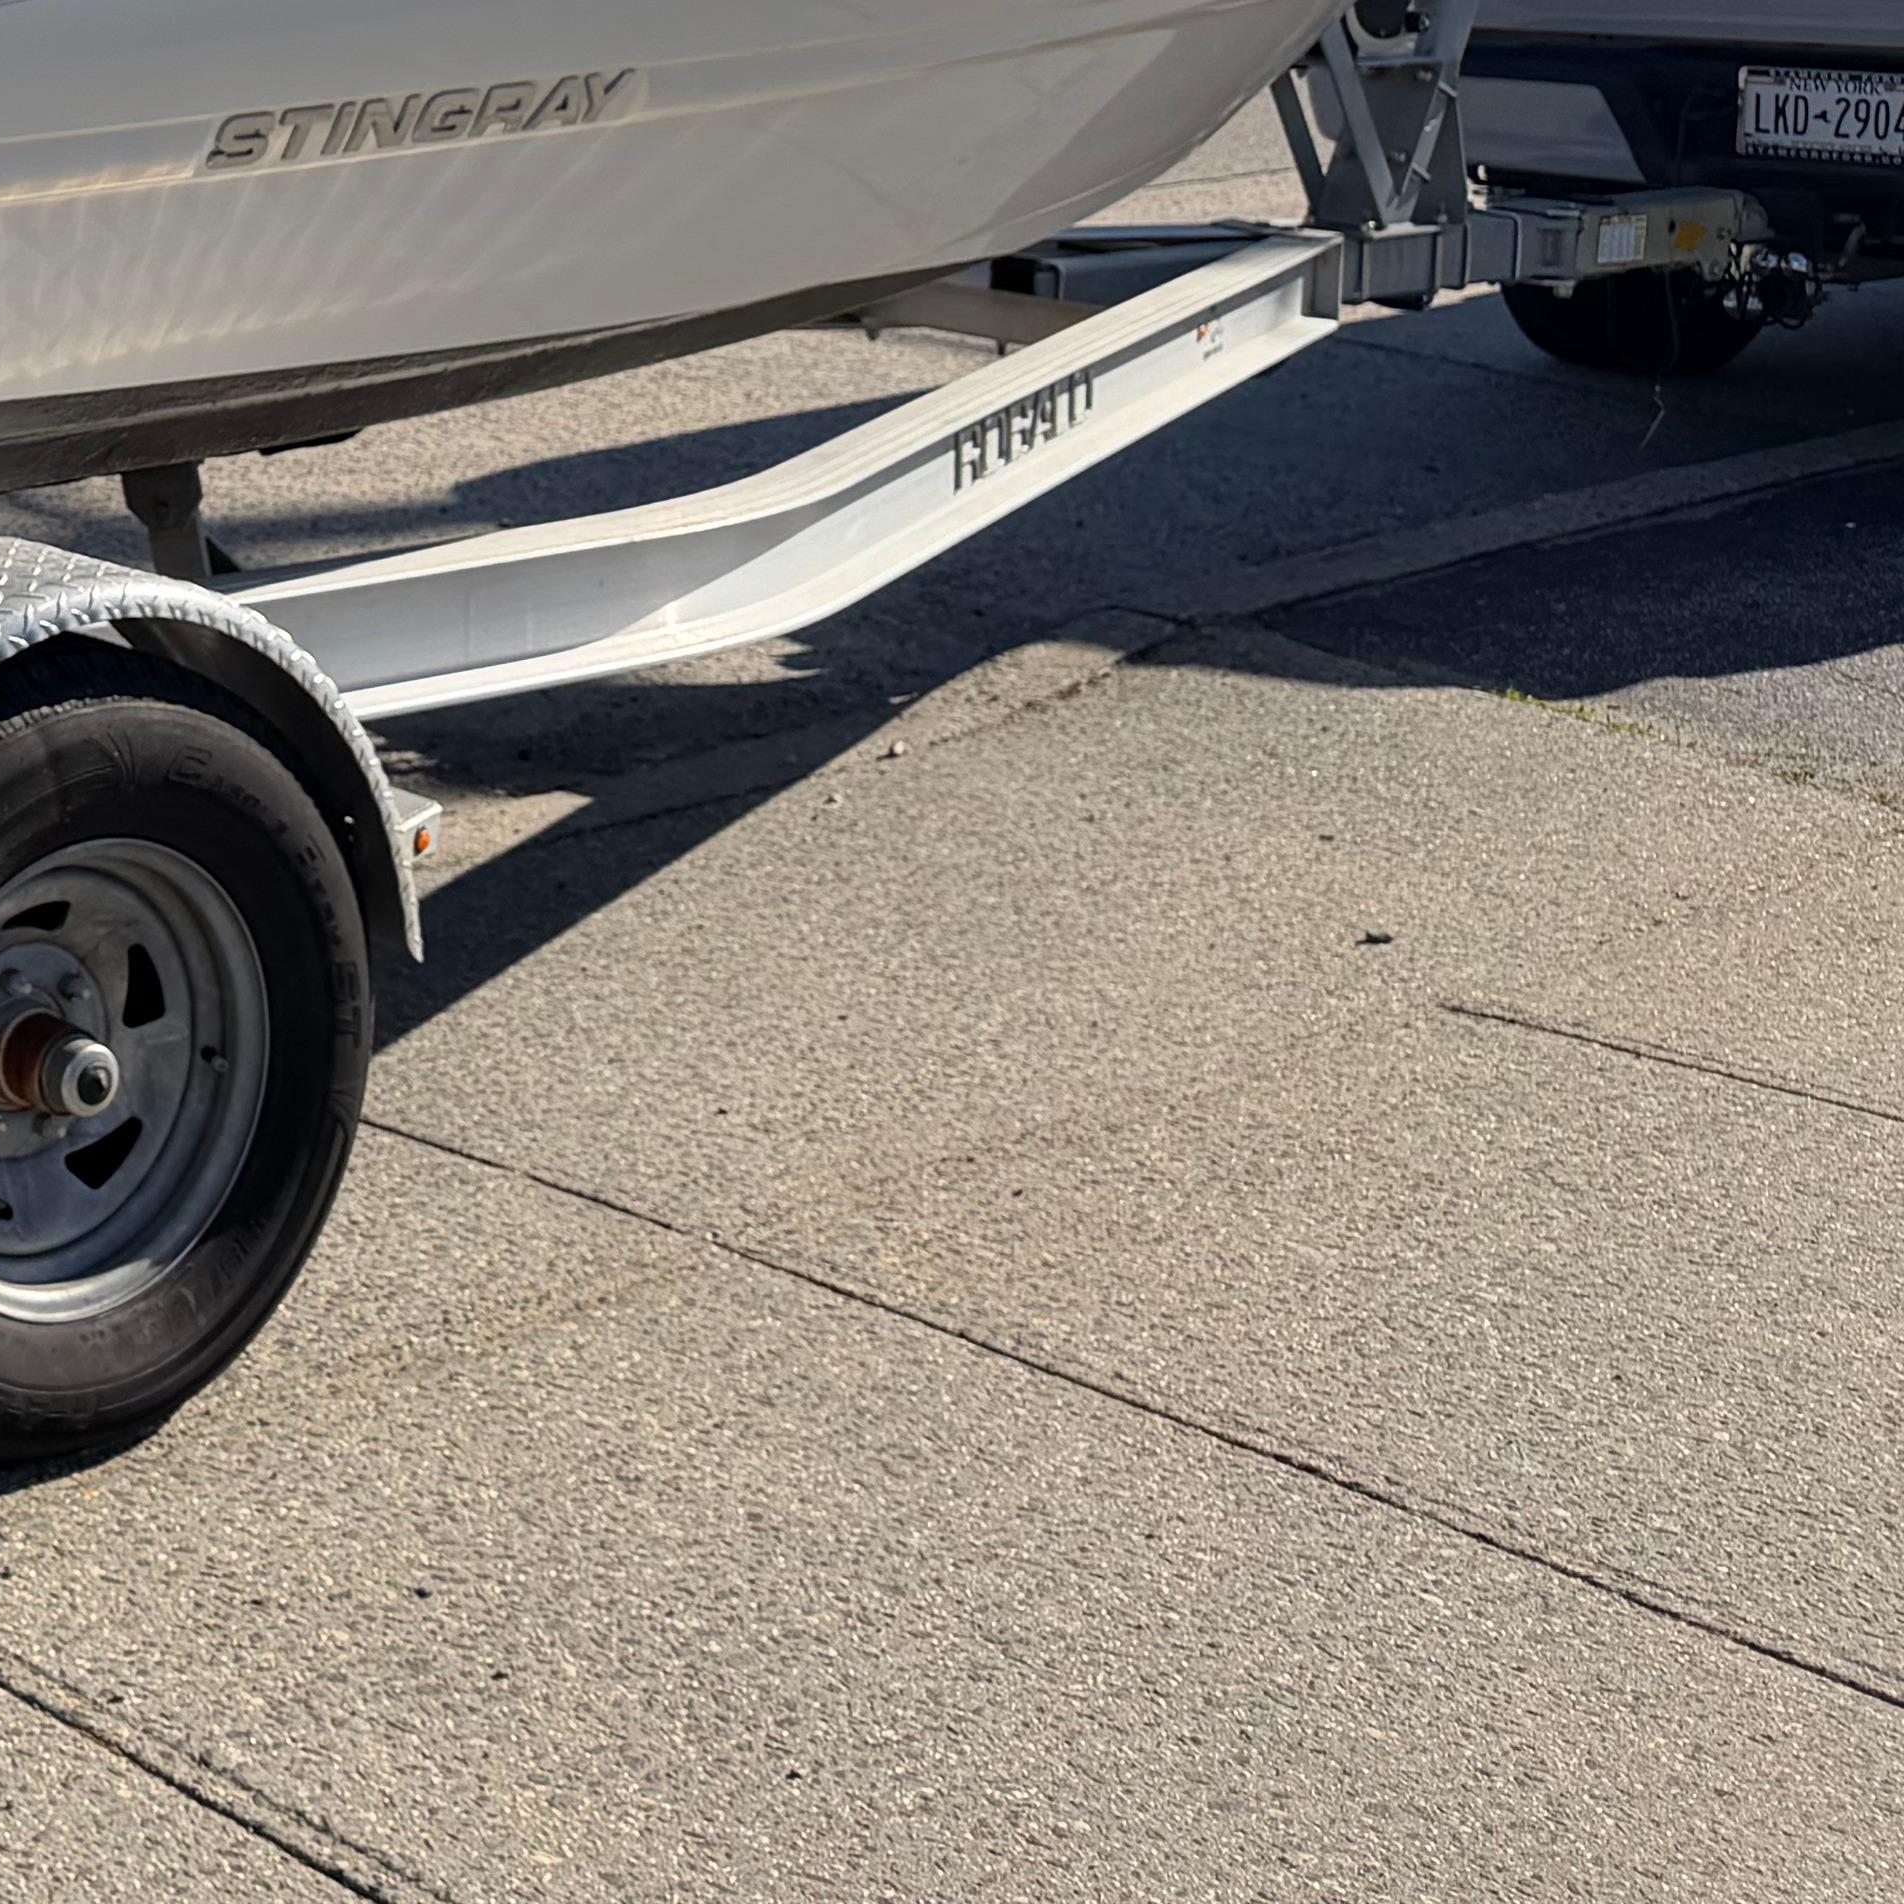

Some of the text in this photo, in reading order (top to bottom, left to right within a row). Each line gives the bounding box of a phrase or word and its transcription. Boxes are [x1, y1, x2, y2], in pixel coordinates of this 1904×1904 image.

[1790, 77, 1879, 95] NEW YORK
[205, 67, 636, 169] STINGRAY
[1755, 93, 1809, 135] LKD
